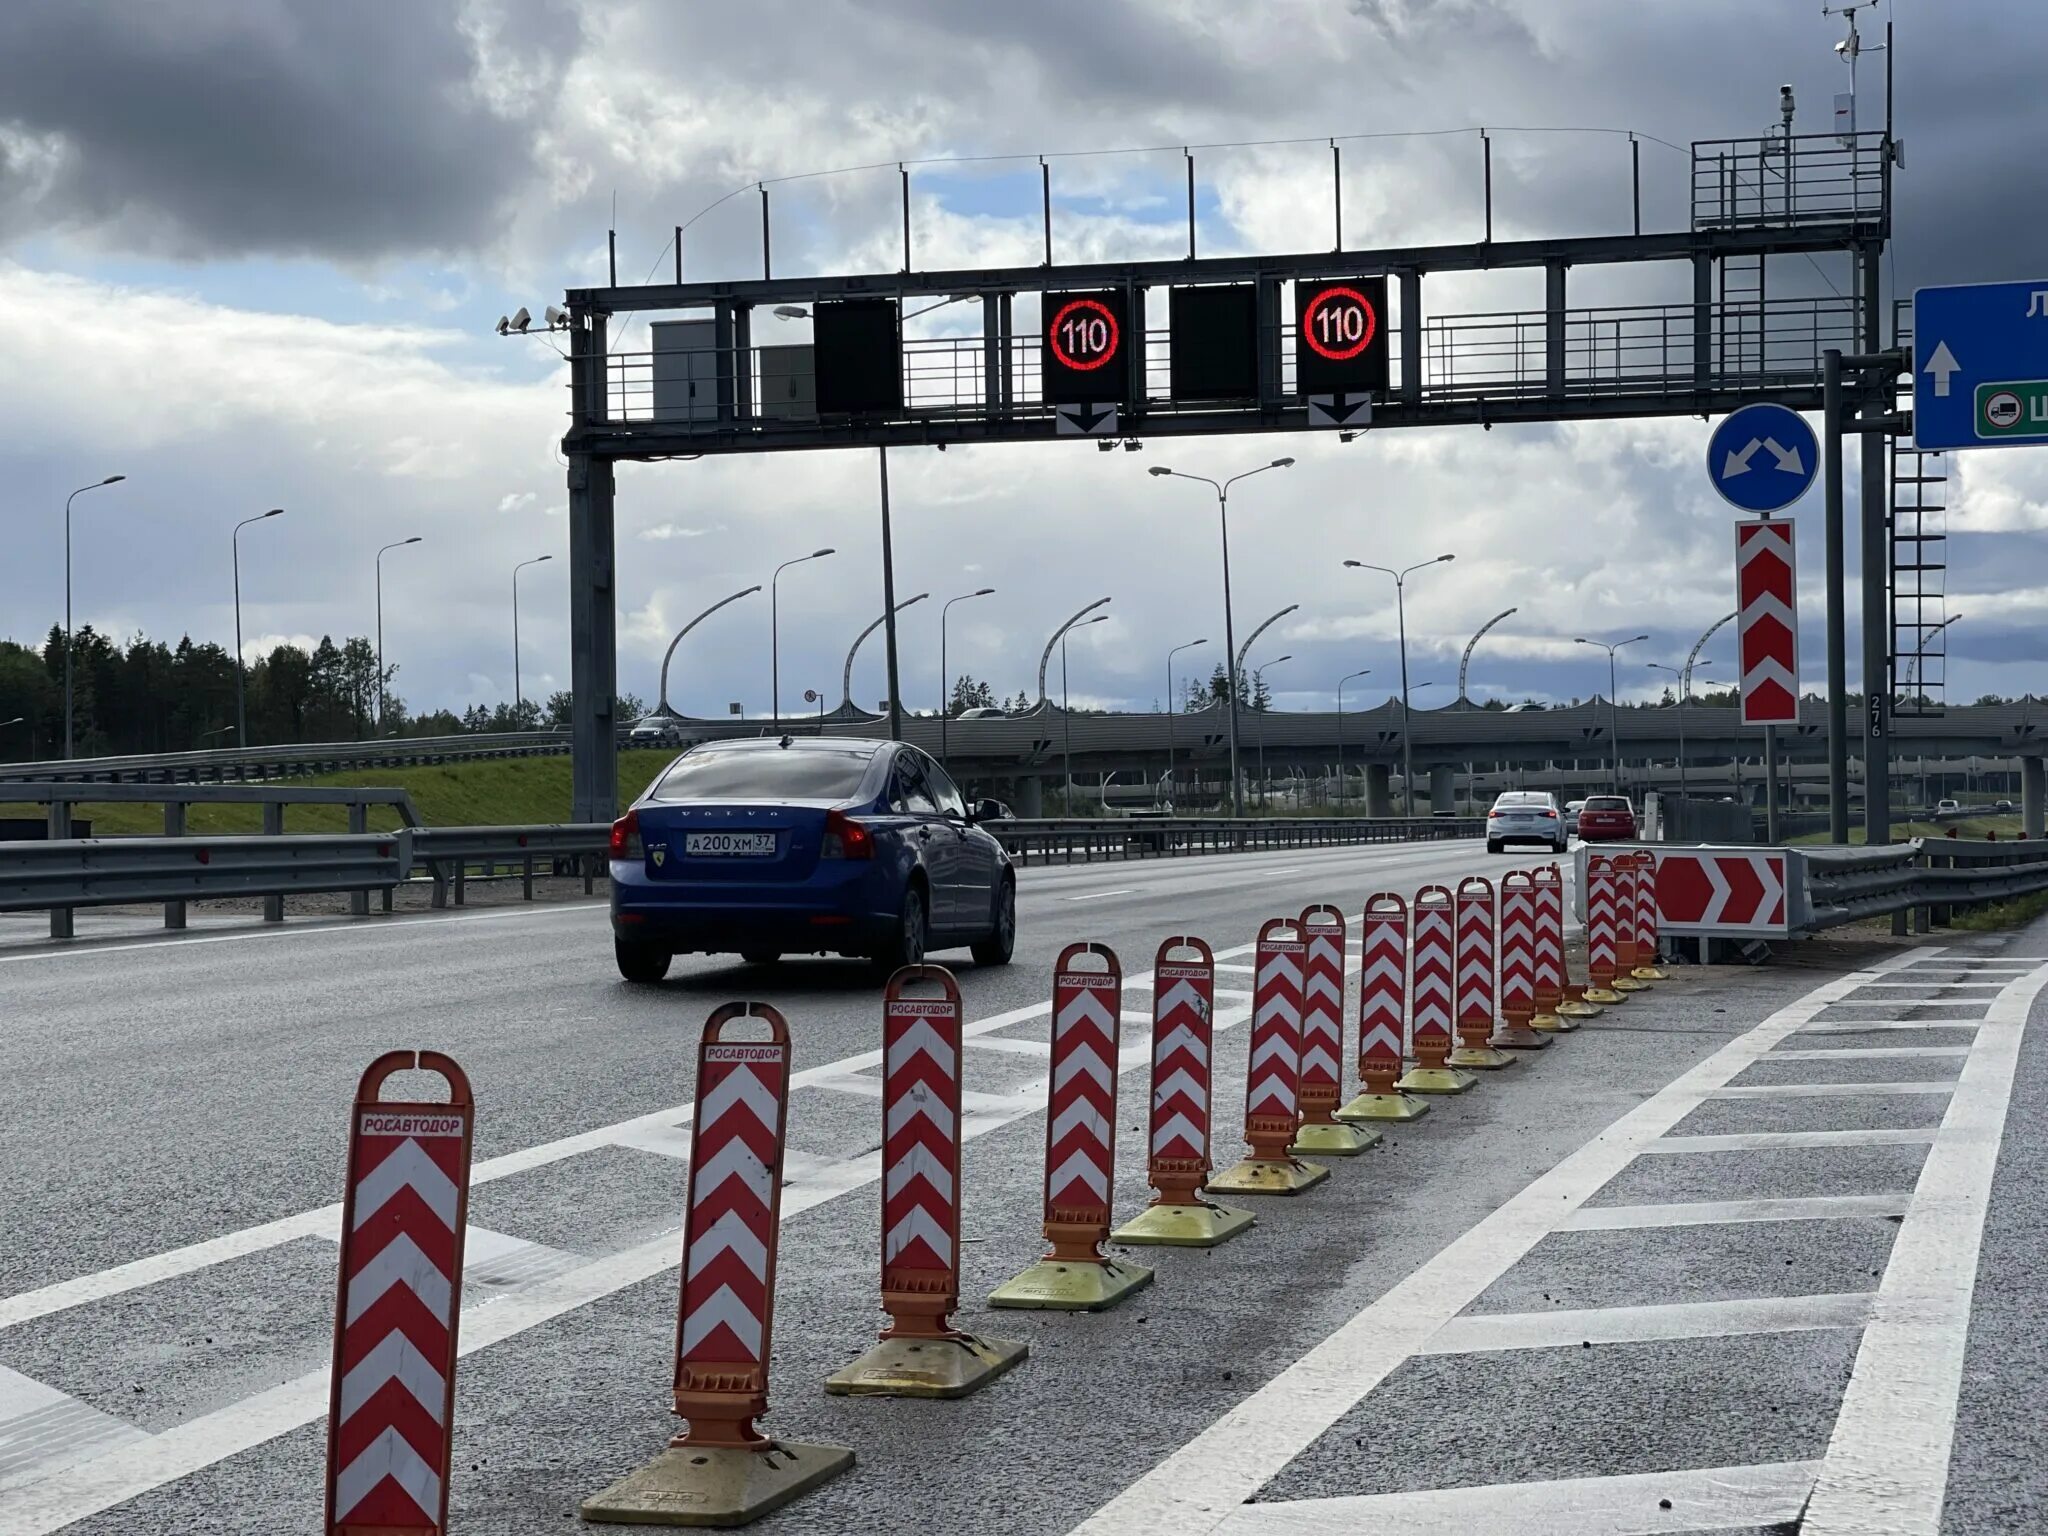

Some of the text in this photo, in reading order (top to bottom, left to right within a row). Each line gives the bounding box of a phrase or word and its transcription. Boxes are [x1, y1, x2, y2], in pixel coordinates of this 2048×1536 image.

[1317, 306, 1364, 343] 110
[1062, 318, 1108, 354] 110
[756, 834, 770, 847] 37
[1260, 943, 1304, 952] РОСАВТОДОР
[1160, 968, 1208, 977] РОСАВТОДОР
[1060, 975, 1114, 986] РОСАВТОДОР
[891, 1004, 953, 1014] РОСАВТОДОР
[708, 1048, 780, 1059] РОСАВТОДОР
[364, 1117, 460, 1133] РОСАВТОДОР
